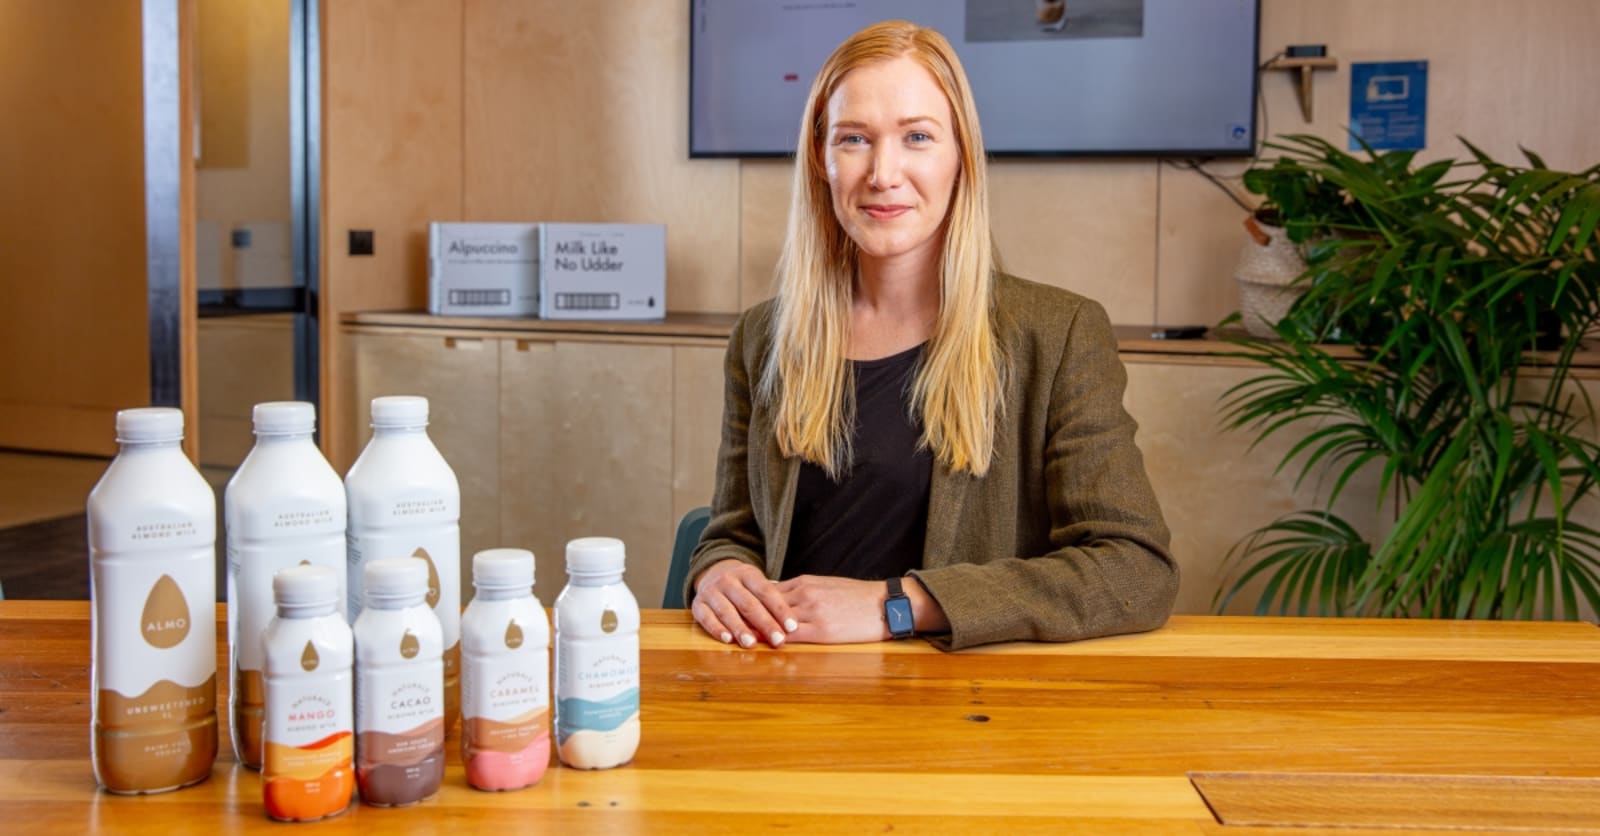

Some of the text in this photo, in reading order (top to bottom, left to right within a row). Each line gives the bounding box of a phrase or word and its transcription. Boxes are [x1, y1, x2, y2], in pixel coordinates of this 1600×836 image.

[449, 240, 518, 258] Alpuccino
[555, 241, 618, 255] Milk Like
[555, 258, 577, 272] No
[582, 257, 624, 272] Udder
[146, 618, 186, 632] ALMO
[489, 685, 540, 698] CARAMEL
[127, 697, 205, 715] UNSWEETENED
[390, 695, 431, 710] CACAO
[288, 709, 335, 722] MANGO
